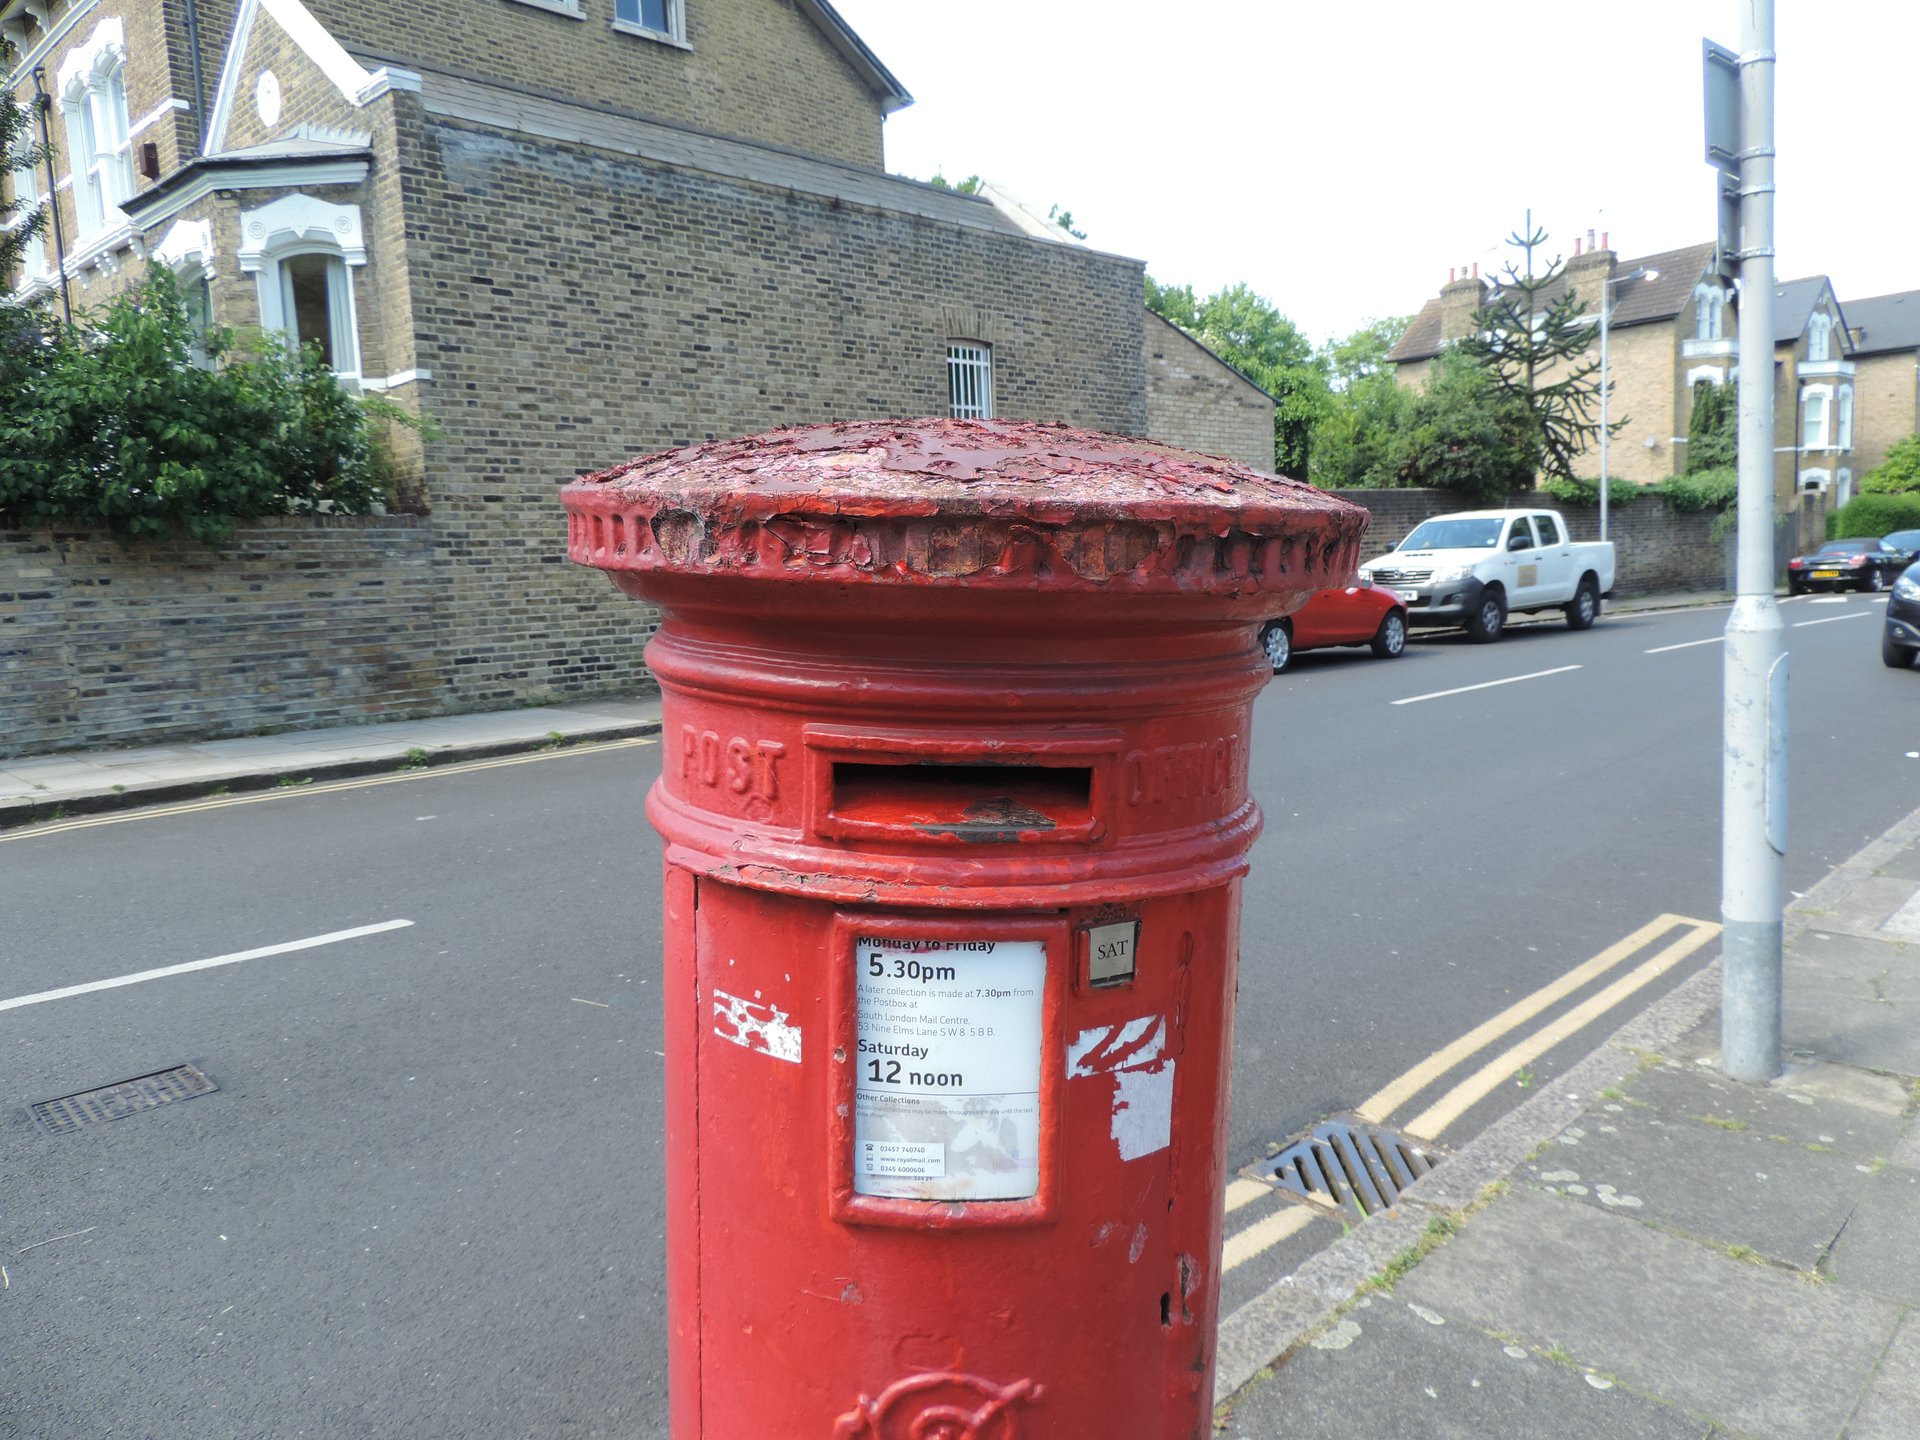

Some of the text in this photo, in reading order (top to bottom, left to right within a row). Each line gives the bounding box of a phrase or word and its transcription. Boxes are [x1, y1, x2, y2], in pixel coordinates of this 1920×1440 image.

[682, 724, 785, 803] POST
[1097, 939, 1129, 960] SAT
[869, 952, 956, 984] 5.30pm
[857, 984, 1034, 999] A later collection is made at 7.30pm from
[857, 996, 918, 1009] the Postbox at
[858, 1009, 971, 1025] South London Mail Centre,
[858, 1021, 869, 1031] 53
[871, 1023, 891, 1033] Nine
[893, 1025, 914, 1035] Elms
[916, 1026, 938, 1036] Lane
[858, 1039, 929, 1060] Saturday
[867, 1058, 963, 1087] 12 noon
[856, 1092, 920, 1105] Other Collections
[880, 1156, 941, 1164] www.royalmail.com
[880, 1165, 896, 1173] 0345
